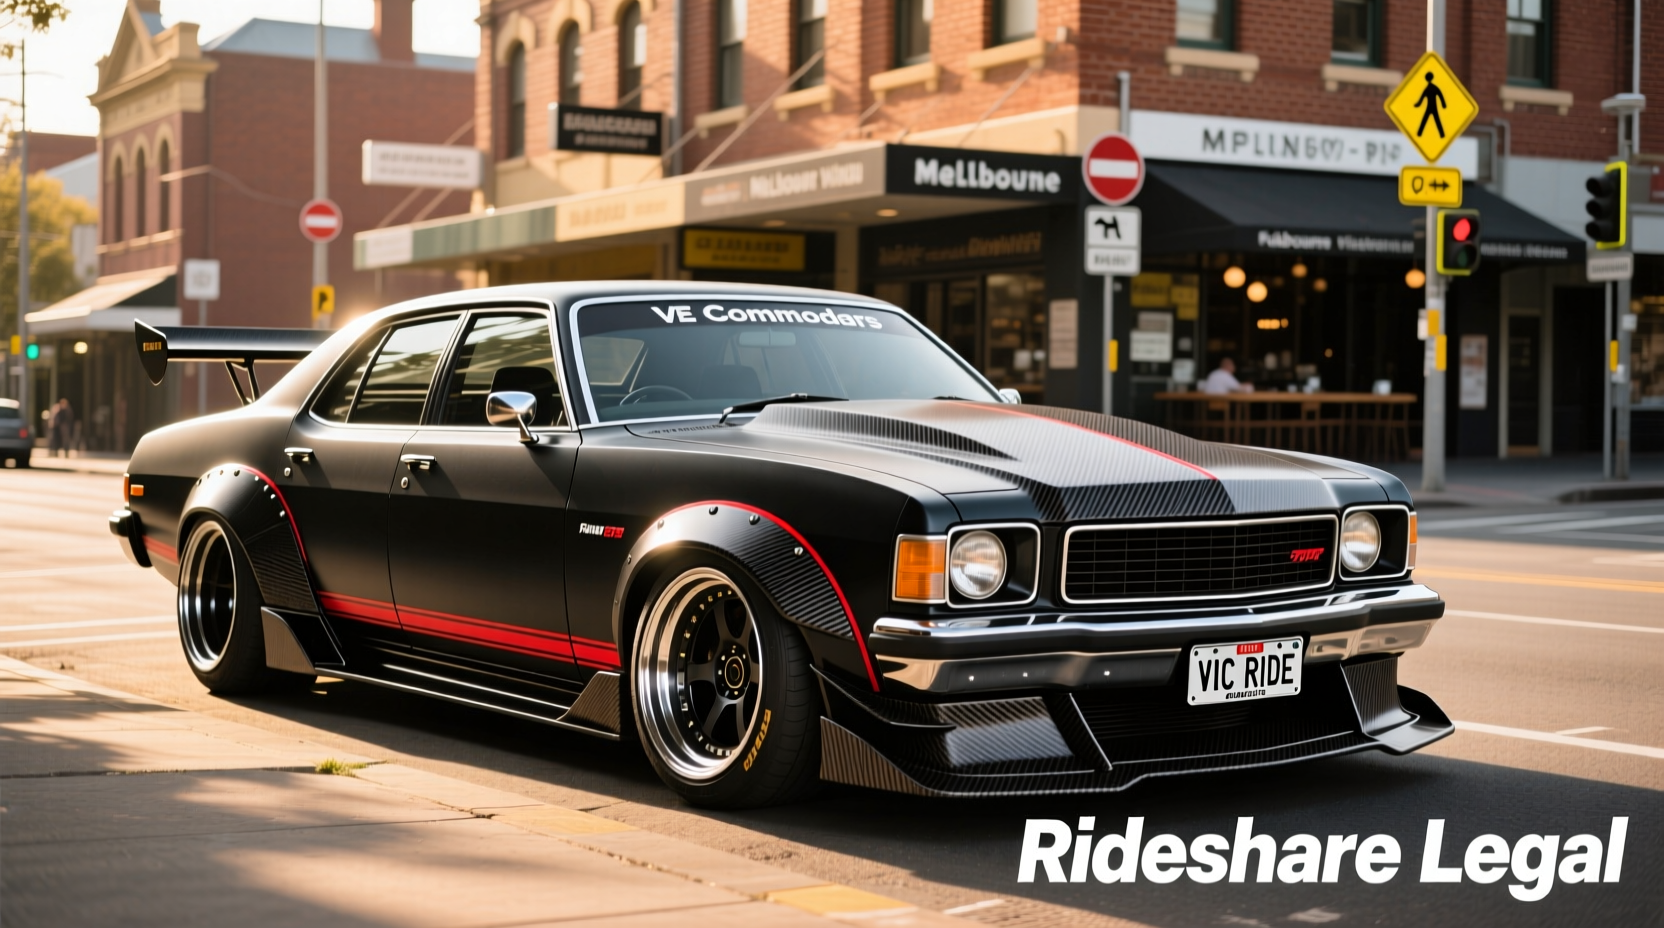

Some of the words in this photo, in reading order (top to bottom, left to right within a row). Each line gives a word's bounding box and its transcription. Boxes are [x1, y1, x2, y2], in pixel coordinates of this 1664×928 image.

[651, 306, 697, 323] VE
[1198, 658, 1235, 692] VIC
[1245, 653, 1295, 688] RIDE
